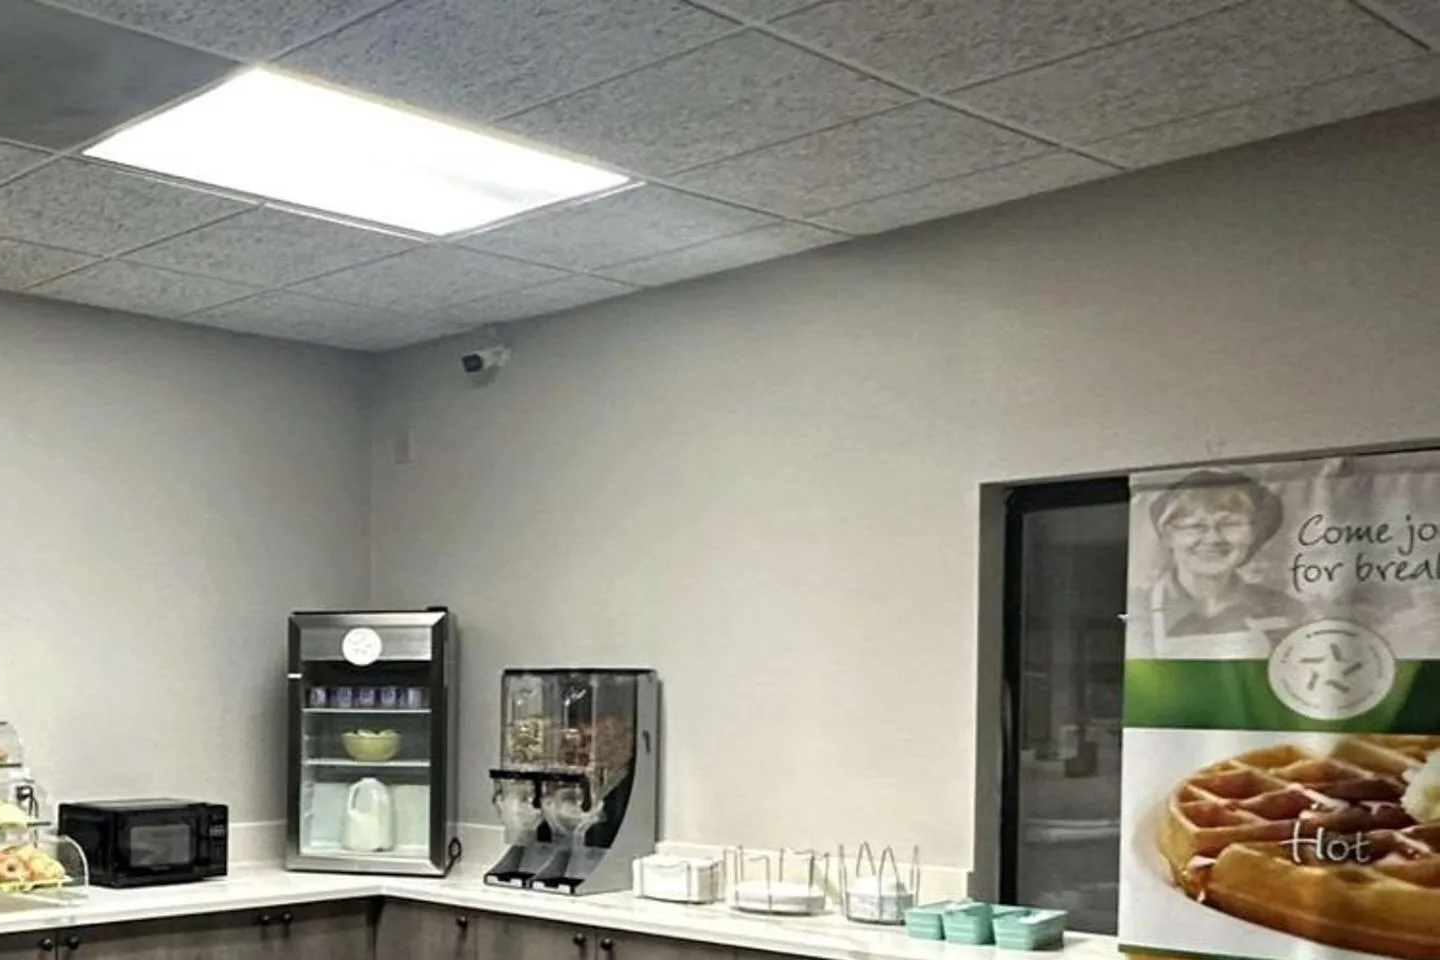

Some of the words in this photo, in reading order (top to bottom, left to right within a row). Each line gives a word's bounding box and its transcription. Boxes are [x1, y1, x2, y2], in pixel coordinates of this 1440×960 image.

[1297, 513, 1394, 547] Come
[1290, 552, 1345, 595] for
[1278, 818, 1372, 864] Hot
